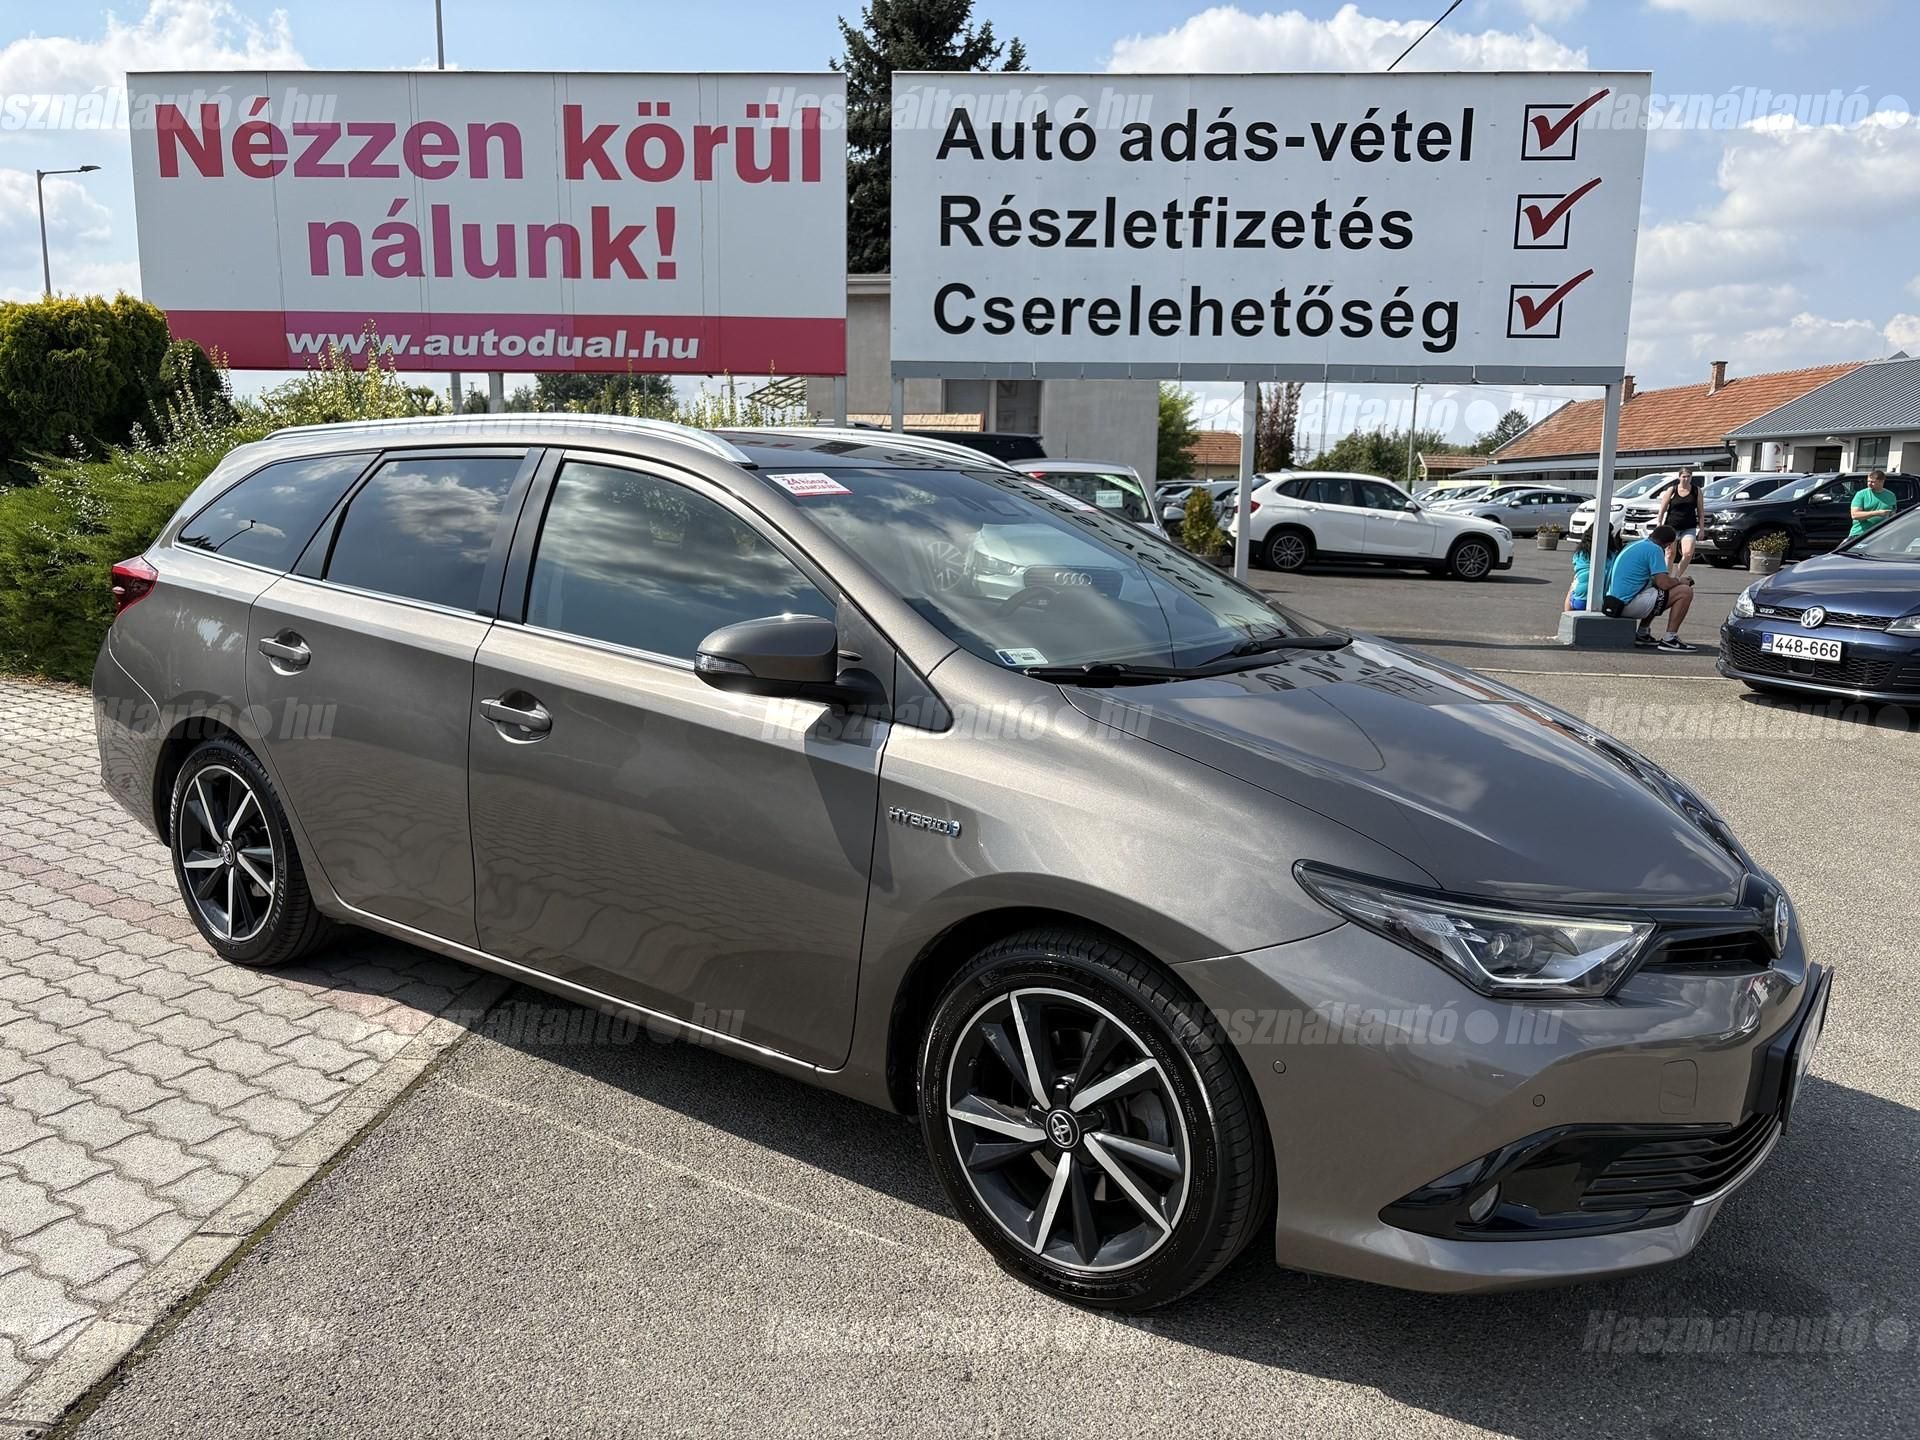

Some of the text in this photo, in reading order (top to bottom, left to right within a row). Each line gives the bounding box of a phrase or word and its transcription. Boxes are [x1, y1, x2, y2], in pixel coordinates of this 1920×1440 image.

[156, 97, 821, 183] Nézzen körül
[935, 106, 1474, 163] Autó adás-vétel
[309, 199, 676, 280] nálunk!
[940, 194, 1413, 250] Részletfizetés
[286, 328, 700, 359] www.autodual.hu
[933, 282, 1459, 356] Cserelehetőség
[1775, 637, 1839, 658] 448-666
